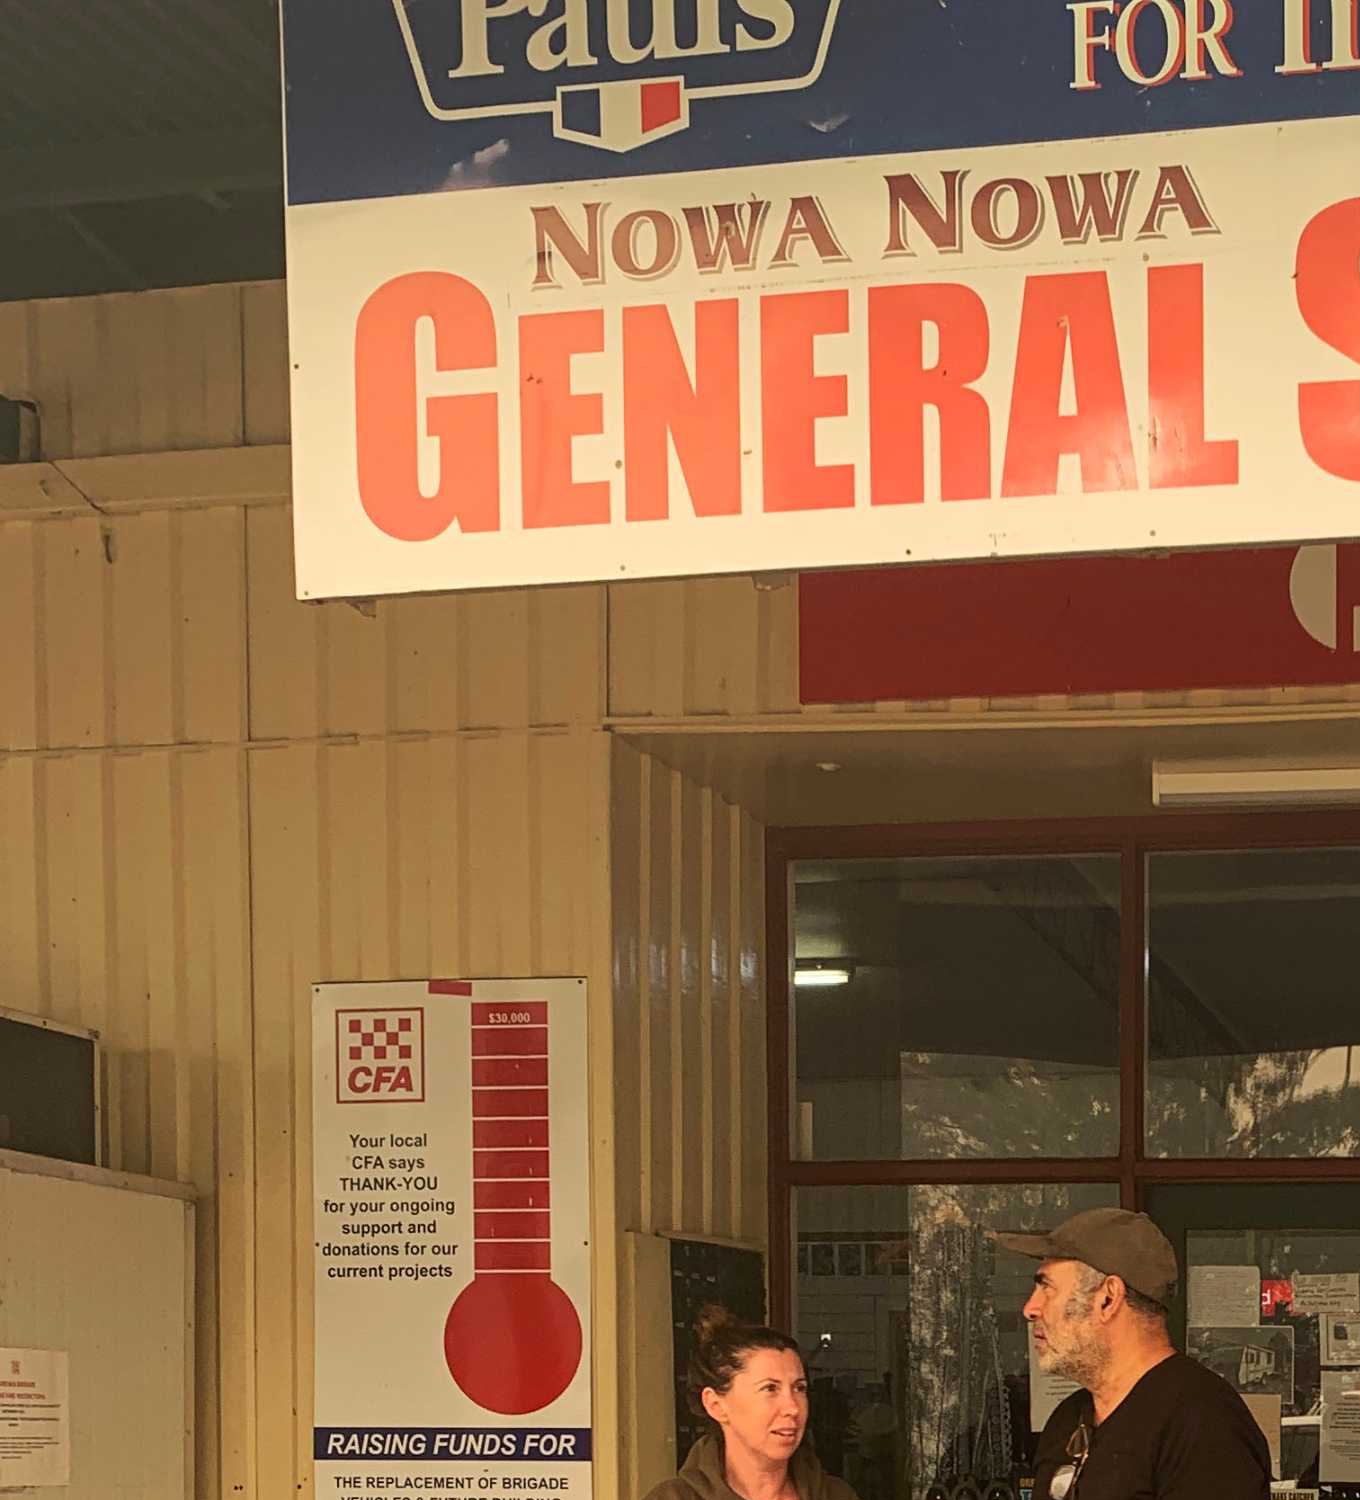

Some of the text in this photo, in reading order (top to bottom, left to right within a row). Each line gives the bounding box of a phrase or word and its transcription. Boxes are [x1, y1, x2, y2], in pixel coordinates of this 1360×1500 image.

[1066, 0, 1244, 90] FOR
[530, 165, 1222, 289] NOWA NOWA
[355, 263, 1239, 542] GENERAL
[488, 1012, 531, 1024] $30,000
[348, 1065, 414, 1093] CFA
[349, 1133, 427, 1149] Your local
[352, 1156, 425, 1171] CFA says
[340, 1176, 438, 1191] THANK-YOU
[324, 1198, 455, 1216] for your ongoing
[342, 1220, 437, 1237] support and
[322, 1242, 459, 1256] donations for our
[328, 1262, 453, 1280] current projects
[327, 1433, 576, 1456] RAISING FUNDS FOR
[334, 1476, 569, 1490] THE REPLACEMENT OF BRIGADE
